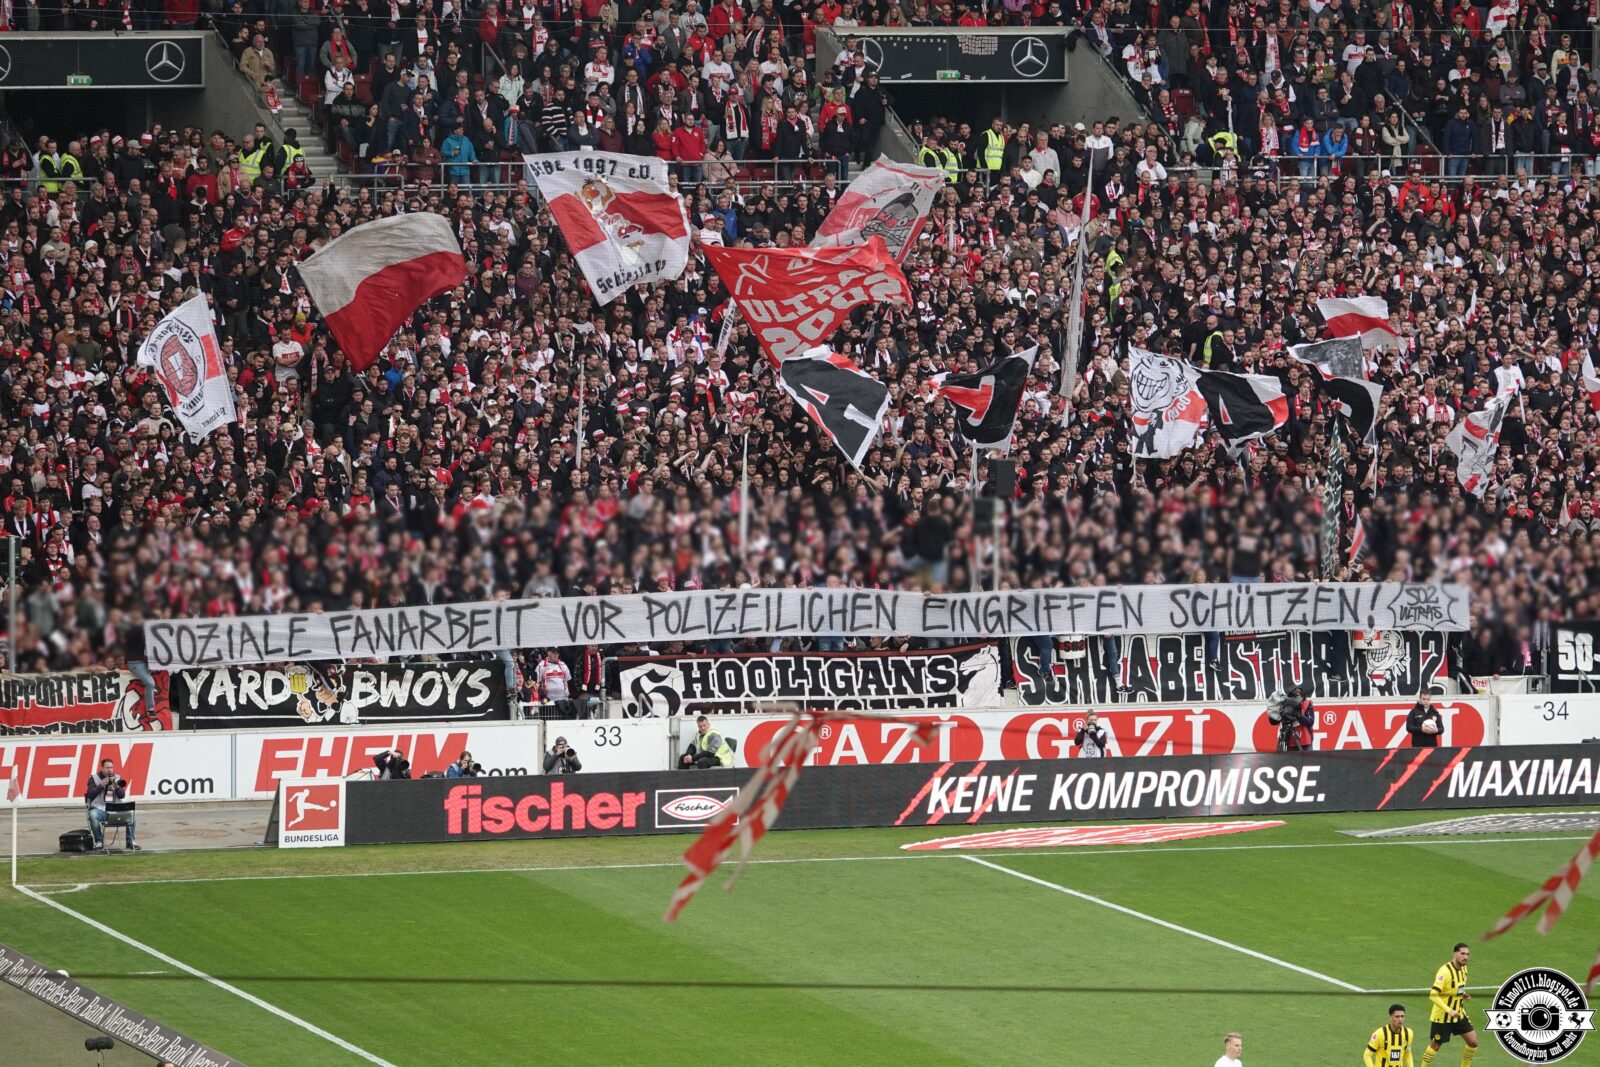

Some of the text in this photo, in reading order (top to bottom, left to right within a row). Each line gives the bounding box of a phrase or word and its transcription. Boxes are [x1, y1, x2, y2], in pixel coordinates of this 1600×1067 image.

[151, 616, 312, 666] SOZIALE
[330, 601, 540, 655] FANARBEIT
[561, 599, 626, 642] VOR
[642, 591, 899, 638] POLIZEILICHEN
[922, 590, 1144, 634] EINGRIFFEN
[182, 668, 292, 711] YARD
[351, 668, 492, 709] BWOYS
[677, 657, 958, 698] HOOLIGANS
[594, 726, 622, 746] 33
[444, 781, 646, 834] fischer
[674, 802, 716, 813] fischer
[927, 765, 1326, 815] KEINE KOMPROMISSE.
[284, 833, 339, 844] BUNDESLIGA
